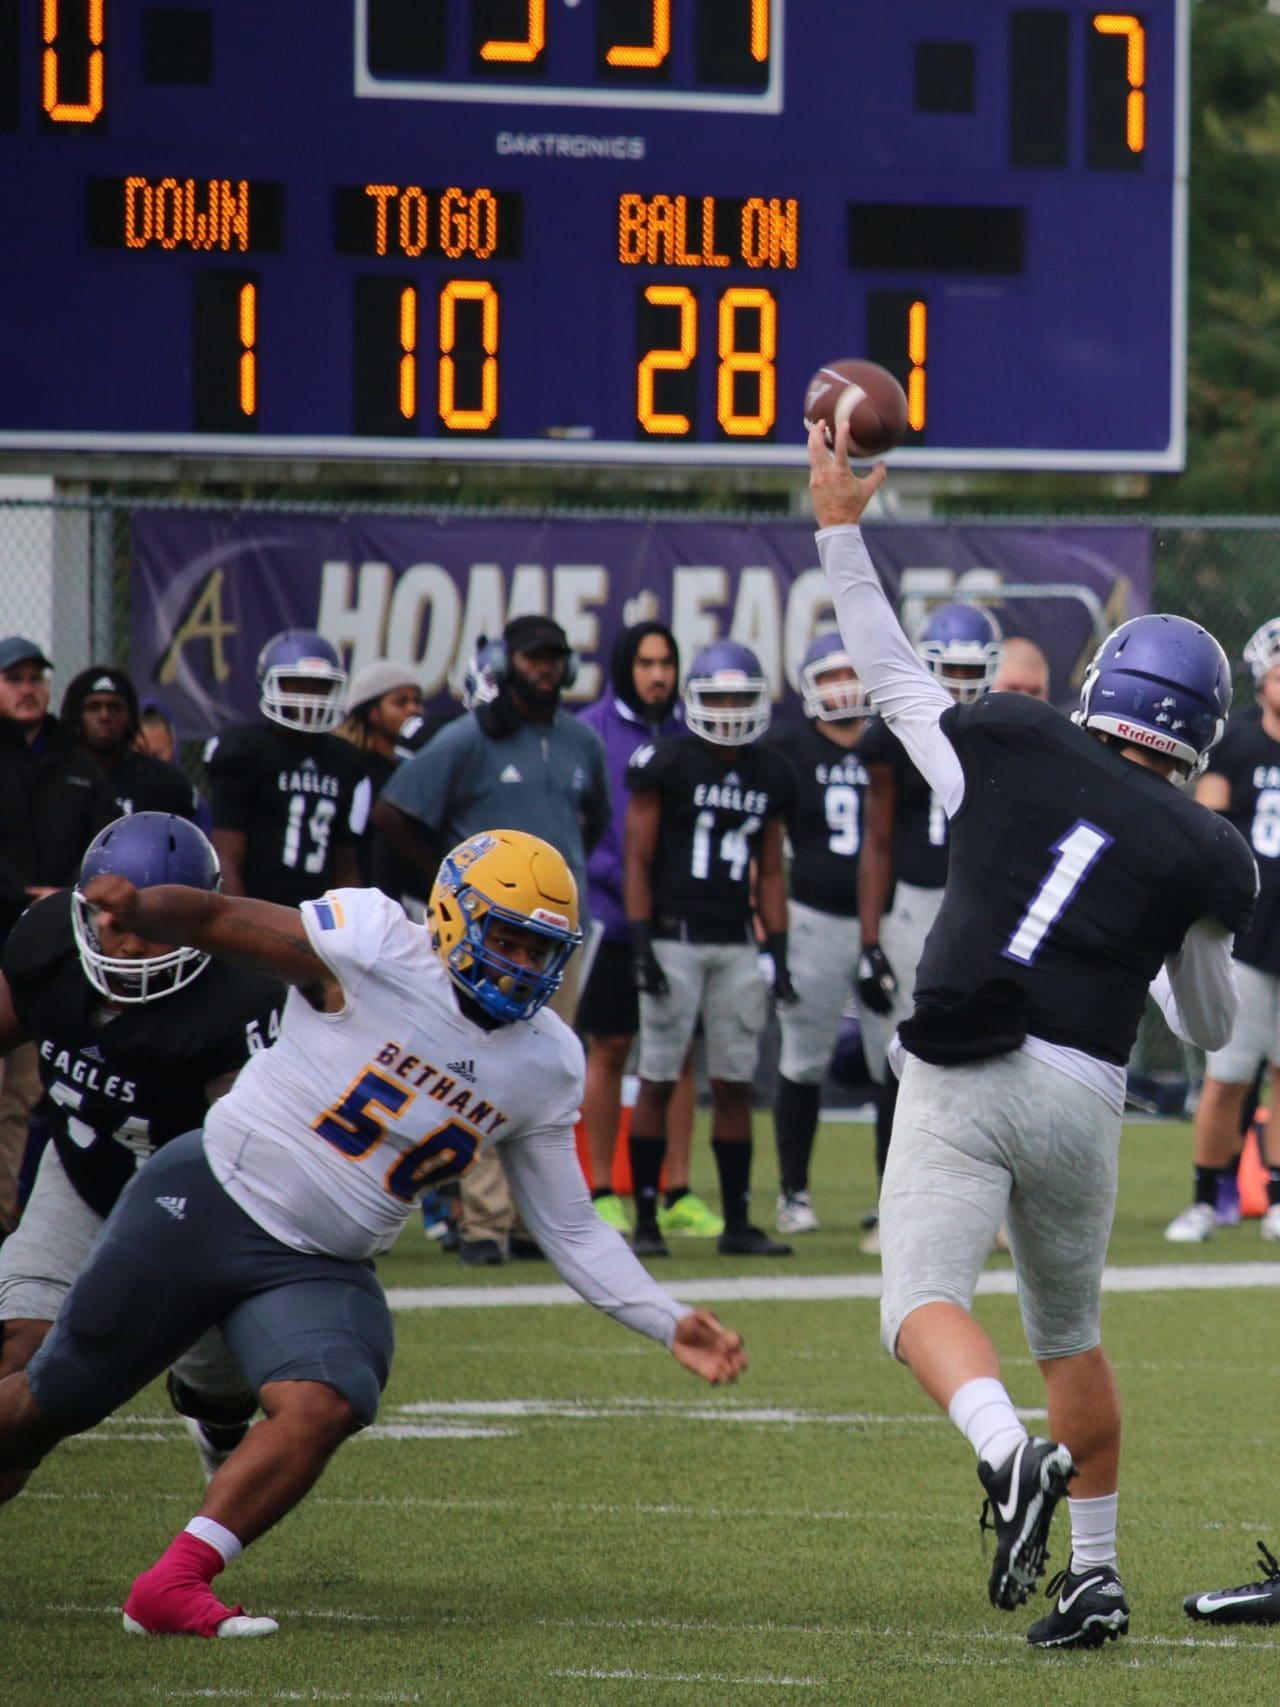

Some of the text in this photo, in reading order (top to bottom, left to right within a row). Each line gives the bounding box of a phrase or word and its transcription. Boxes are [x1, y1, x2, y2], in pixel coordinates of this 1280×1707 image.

[1093, 15, 1146, 152] 7
[125, 176, 249, 253] DOWN
[365, 185, 498, 260] TO GO
[618, 193, 798, 270] BALL ON
[240, 283, 256, 416] 1
[400, 281, 498, 430] 10
[637, 285, 777, 437] 28
[908, 302, 927, 431] 1
[316, 562, 607, 705] HOME
[1117, 723, 1177, 753] Riddell
[278, 770, 339, 797] EAGLES
[693, 784, 769, 815] EAGLES
[824, 785, 860, 856] 9
[692, 811, 761, 882] 14
[1001, 817, 1117, 968] 1
[40, 1039, 136, 1103] EAGLES
[374, 1041, 508, 1134] BETHANY
[309, 1063, 486, 1203] 50
